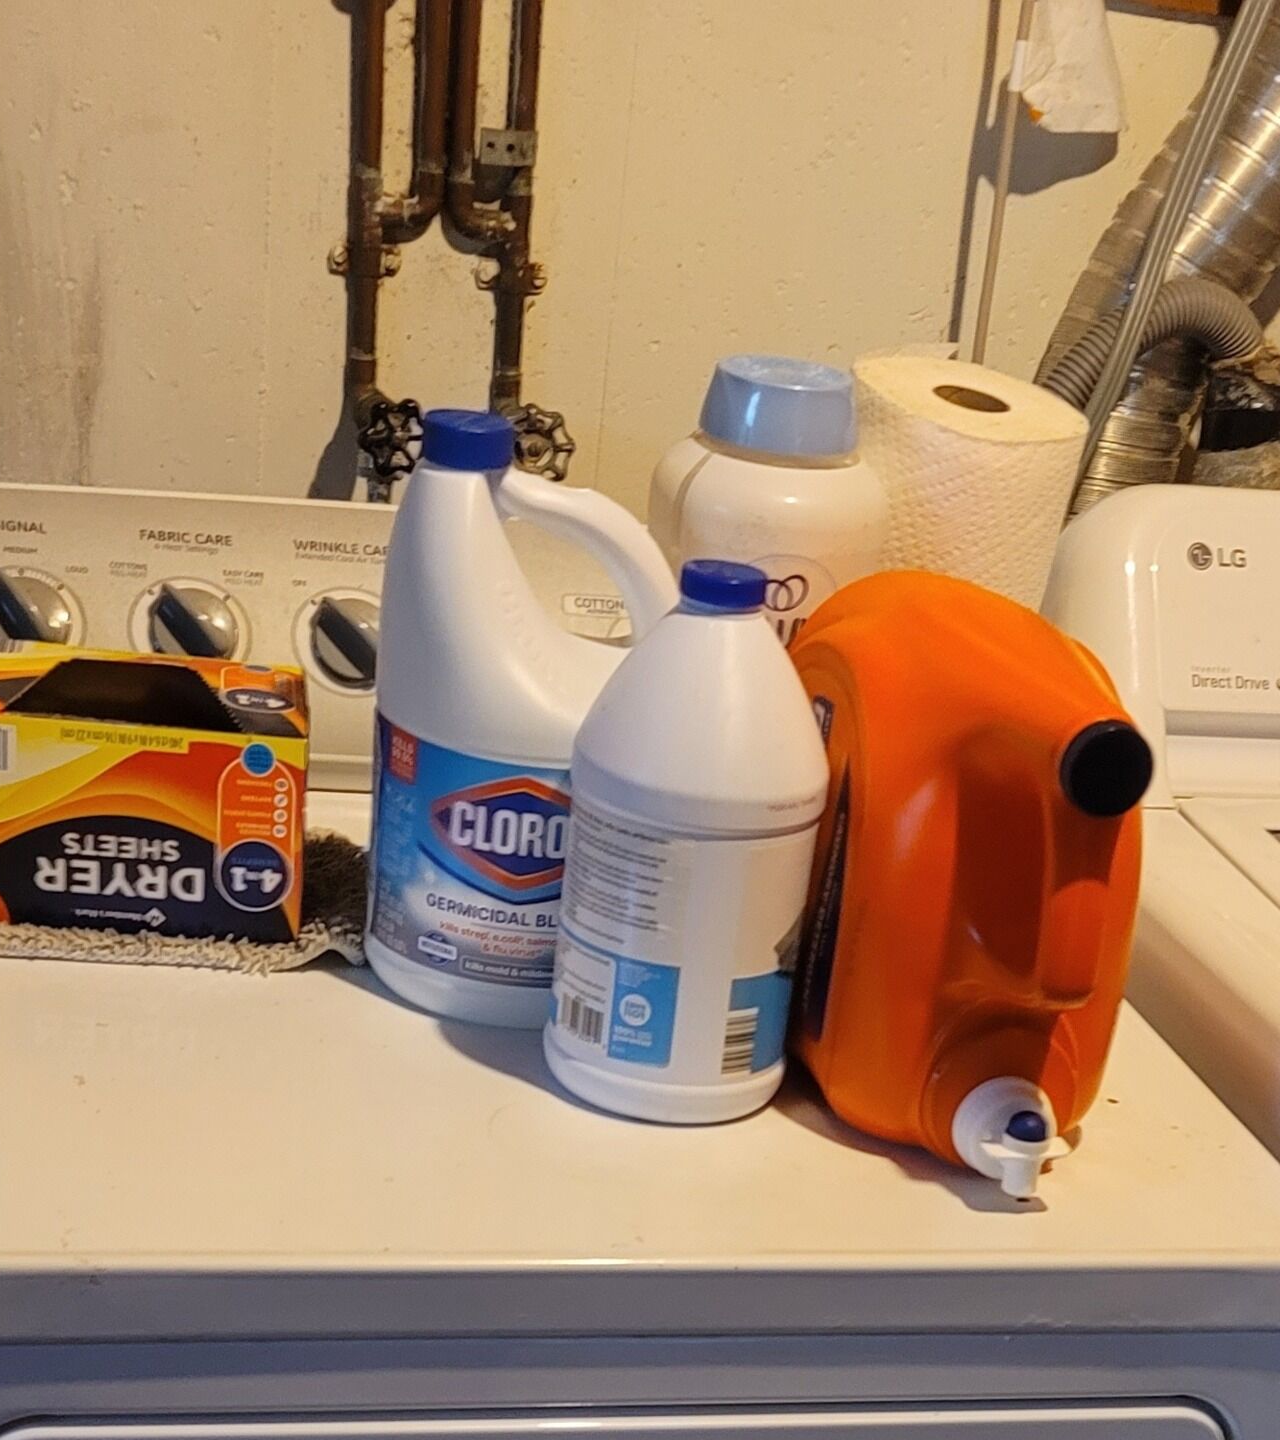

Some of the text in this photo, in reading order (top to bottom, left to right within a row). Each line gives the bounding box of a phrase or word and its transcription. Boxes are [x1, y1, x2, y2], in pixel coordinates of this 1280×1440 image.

[139, 529, 233, 547] FABRIC CARE
[3, 545, 39, 554] MEDIUM
[293, 540, 391, 556] WRINKLE CAR
[1217, 548, 1248, 568] LG
[65, 566, 89, 575] LOUD
[243, 571, 265, 579] CARE
[1191, 674, 1232, 689] Direct
[1235, 676, 1270, 691] Drive
[450, 800, 570, 860] CLORO
[60, 832, 181, 862] SHEETS
[33, 856, 206, 902] DRYER
[425, 893, 531, 927] GERMICIDAL
